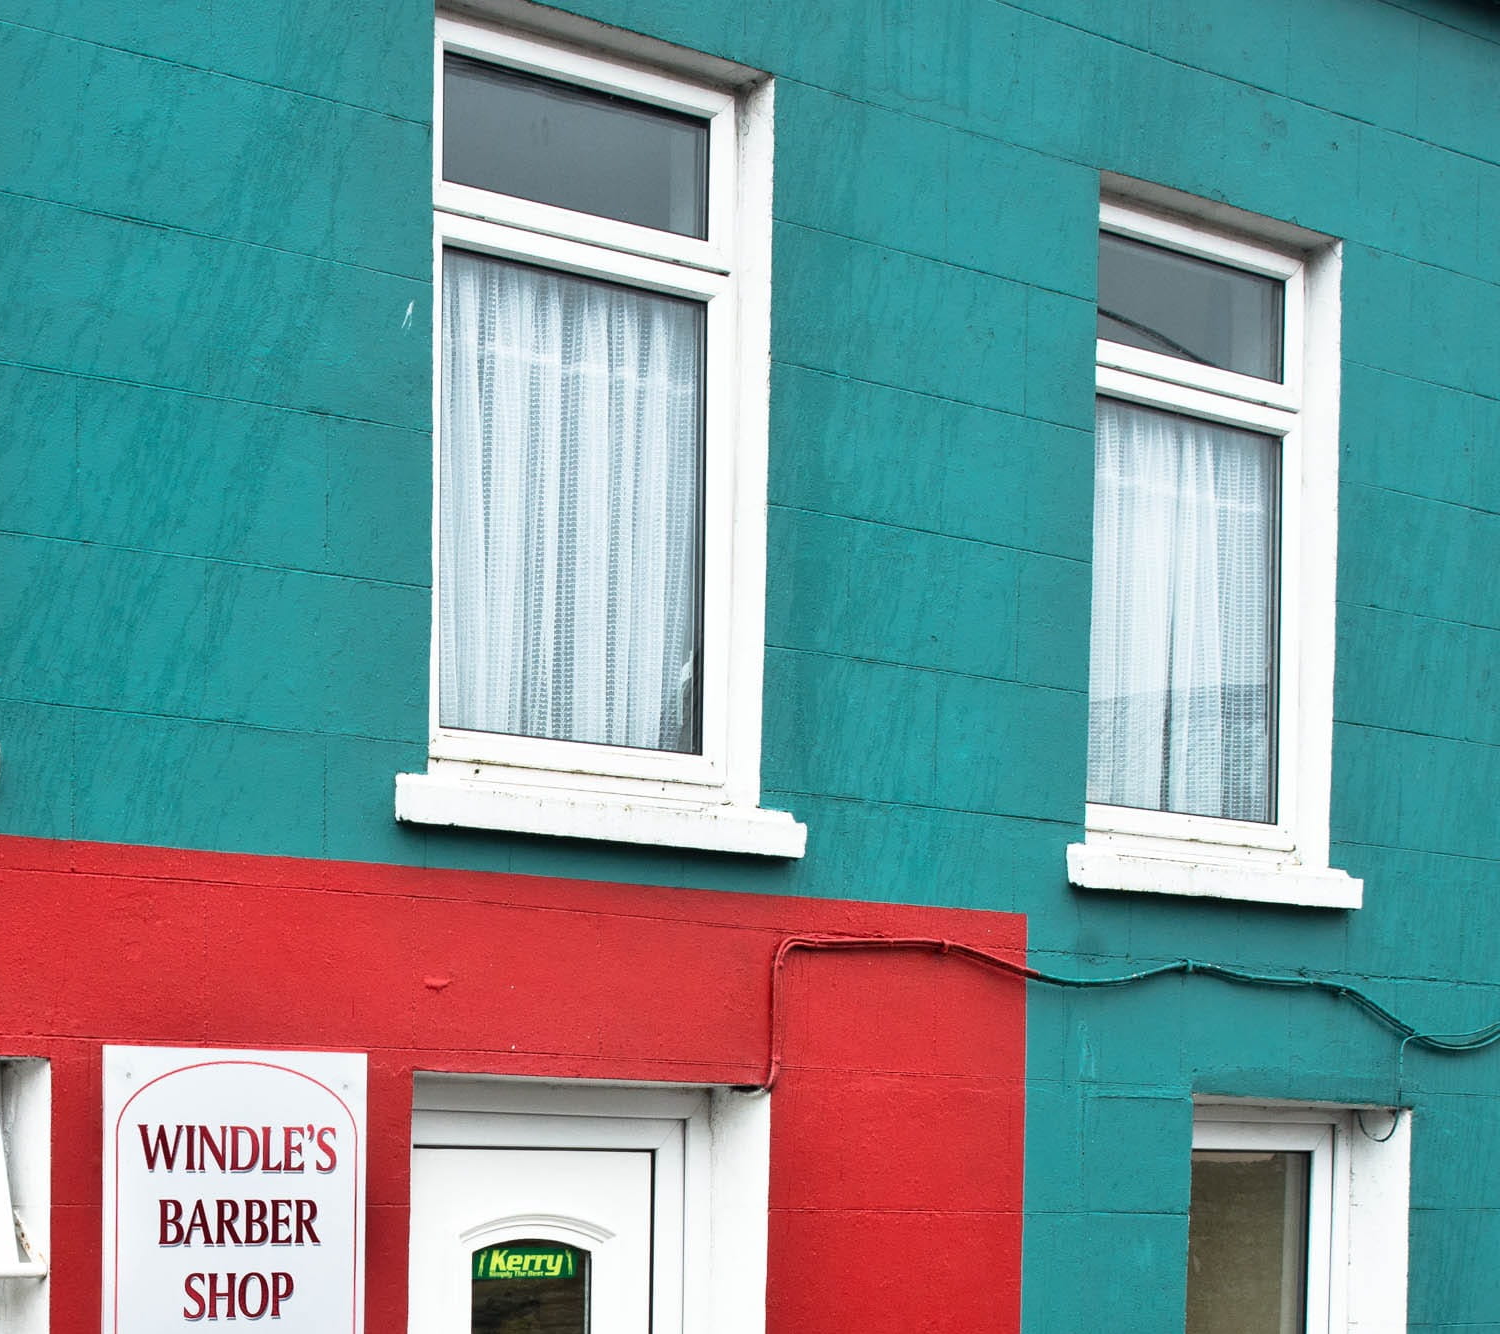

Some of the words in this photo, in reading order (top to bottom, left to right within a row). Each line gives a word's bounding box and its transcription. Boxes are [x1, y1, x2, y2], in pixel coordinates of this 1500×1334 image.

[137, 1124, 338, 1175] WINDLE'S
[158, 1199, 321, 1247] BARBER
[489, 1249, 564, 1276] Kerry
[183, 1271, 294, 1321] SHOP
